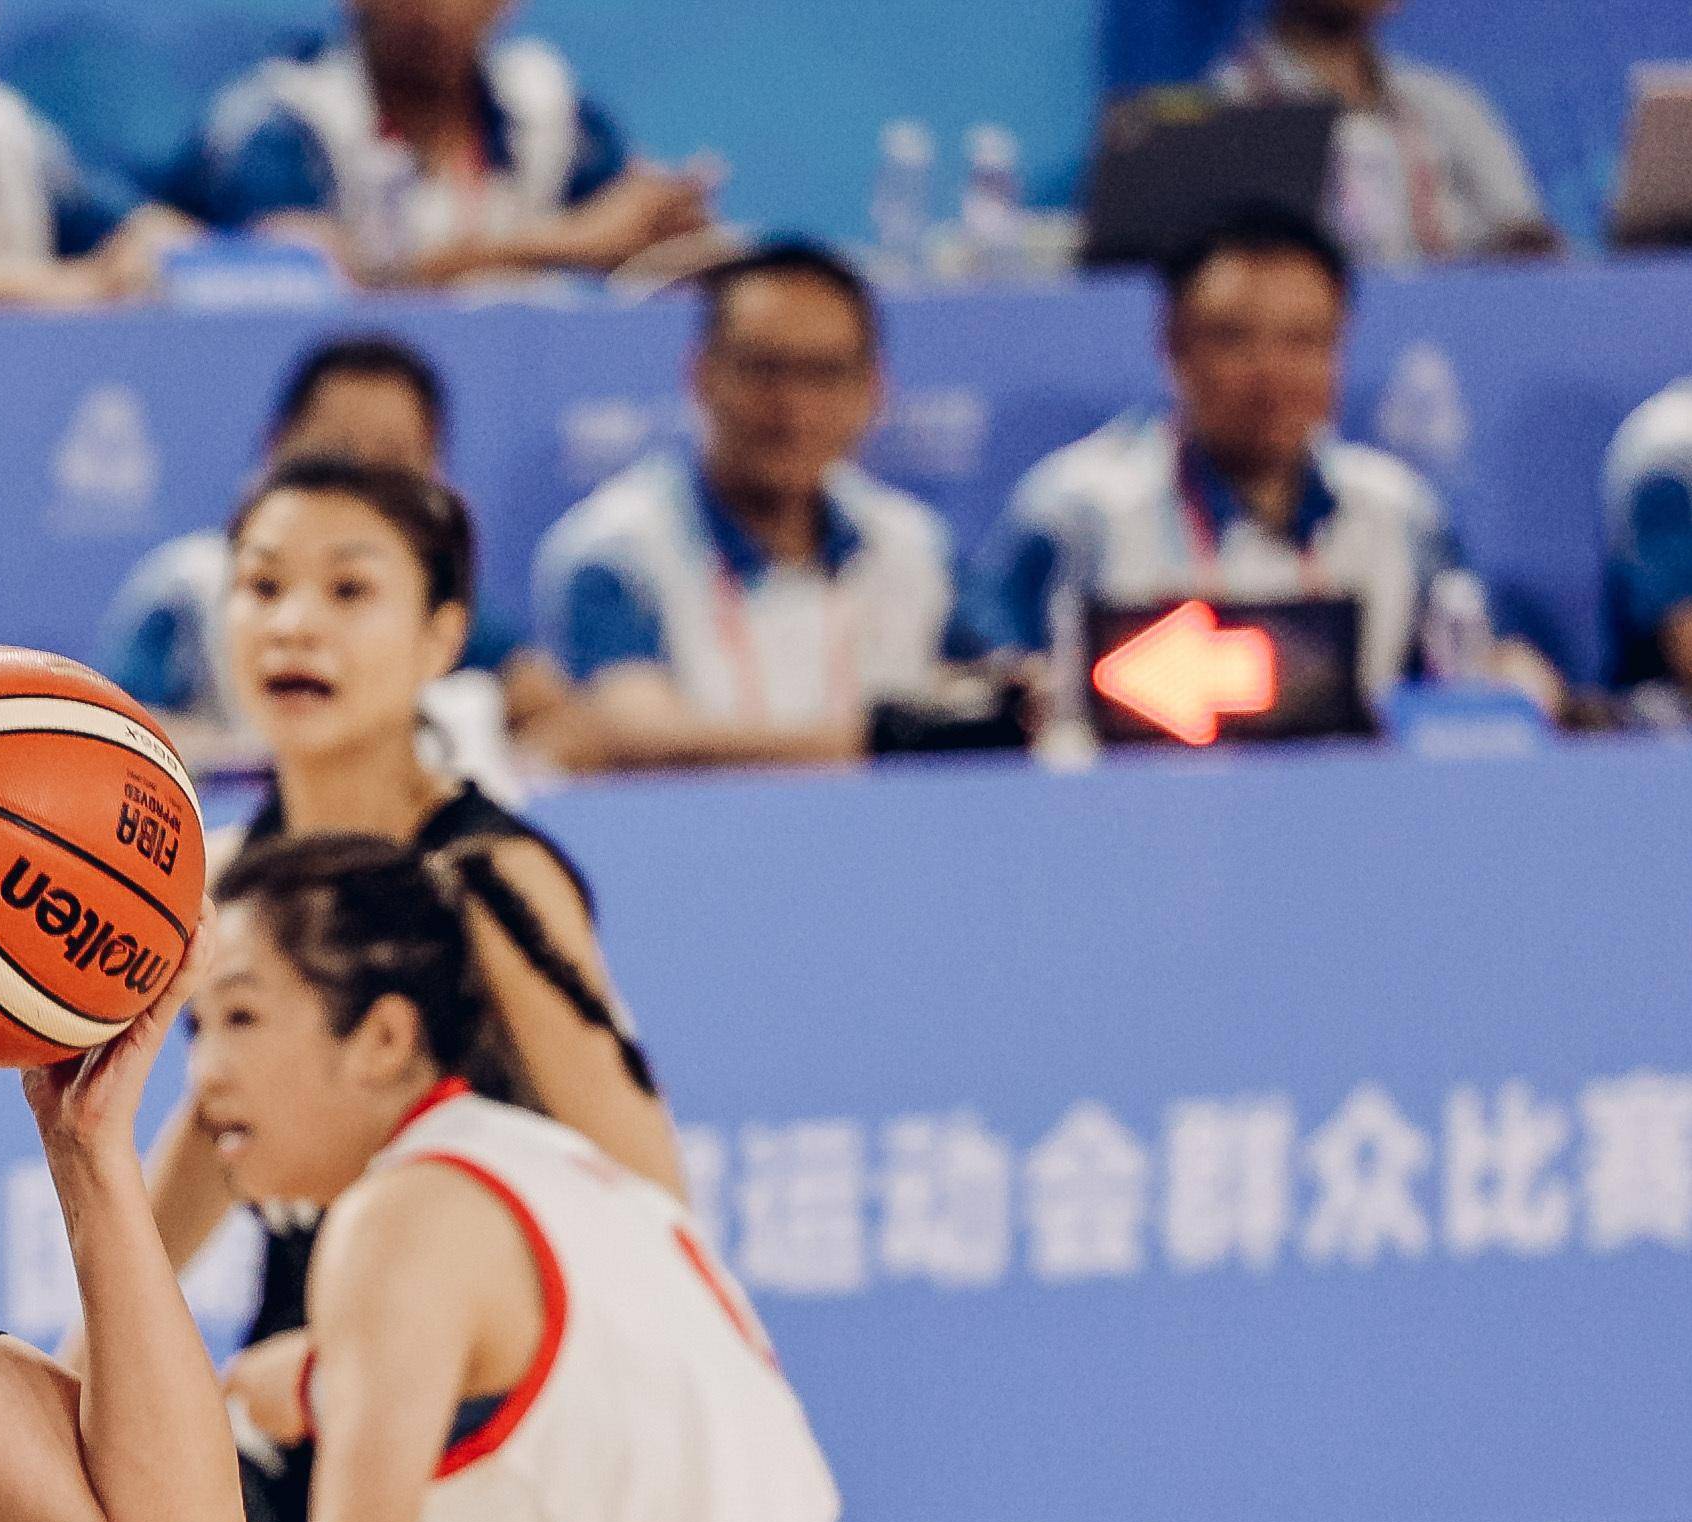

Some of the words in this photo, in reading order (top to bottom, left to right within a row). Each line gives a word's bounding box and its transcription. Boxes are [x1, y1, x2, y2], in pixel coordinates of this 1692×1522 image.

[116, 802, 179, 877] FIBA
[0, 855, 171, 994] molten
[684, 1070, 1692, 1295] 运动会群众比赛
